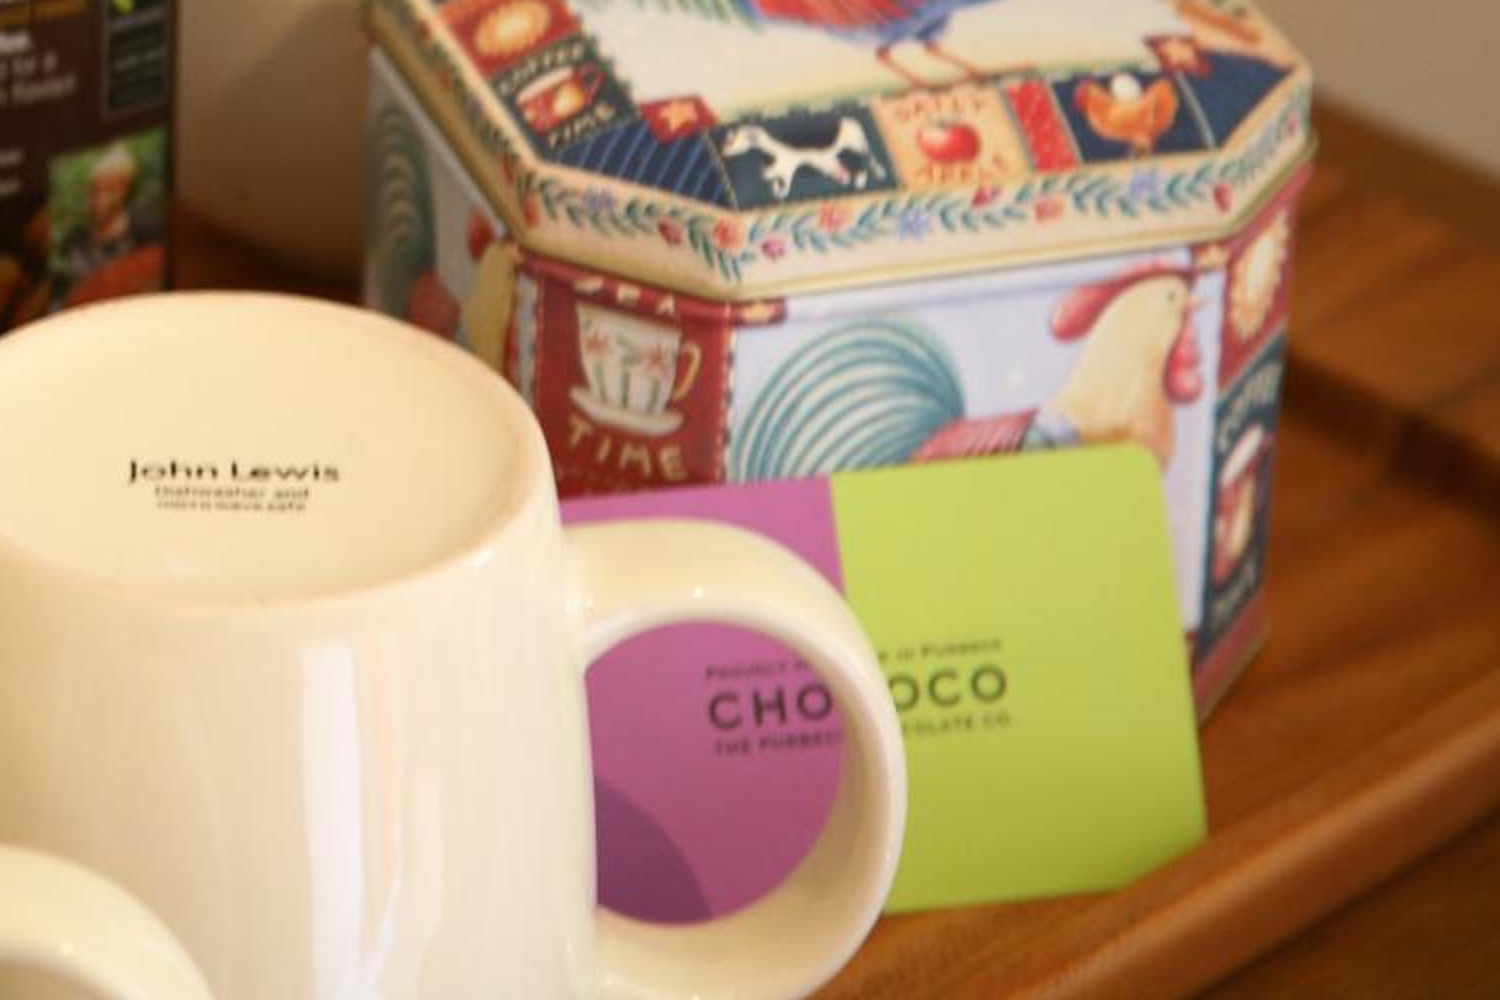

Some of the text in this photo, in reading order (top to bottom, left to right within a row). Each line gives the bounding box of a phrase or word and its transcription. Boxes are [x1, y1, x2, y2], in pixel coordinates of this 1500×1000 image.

[569, 413, 687, 481] TIME
[128, 459, 341, 487] John Lewis
